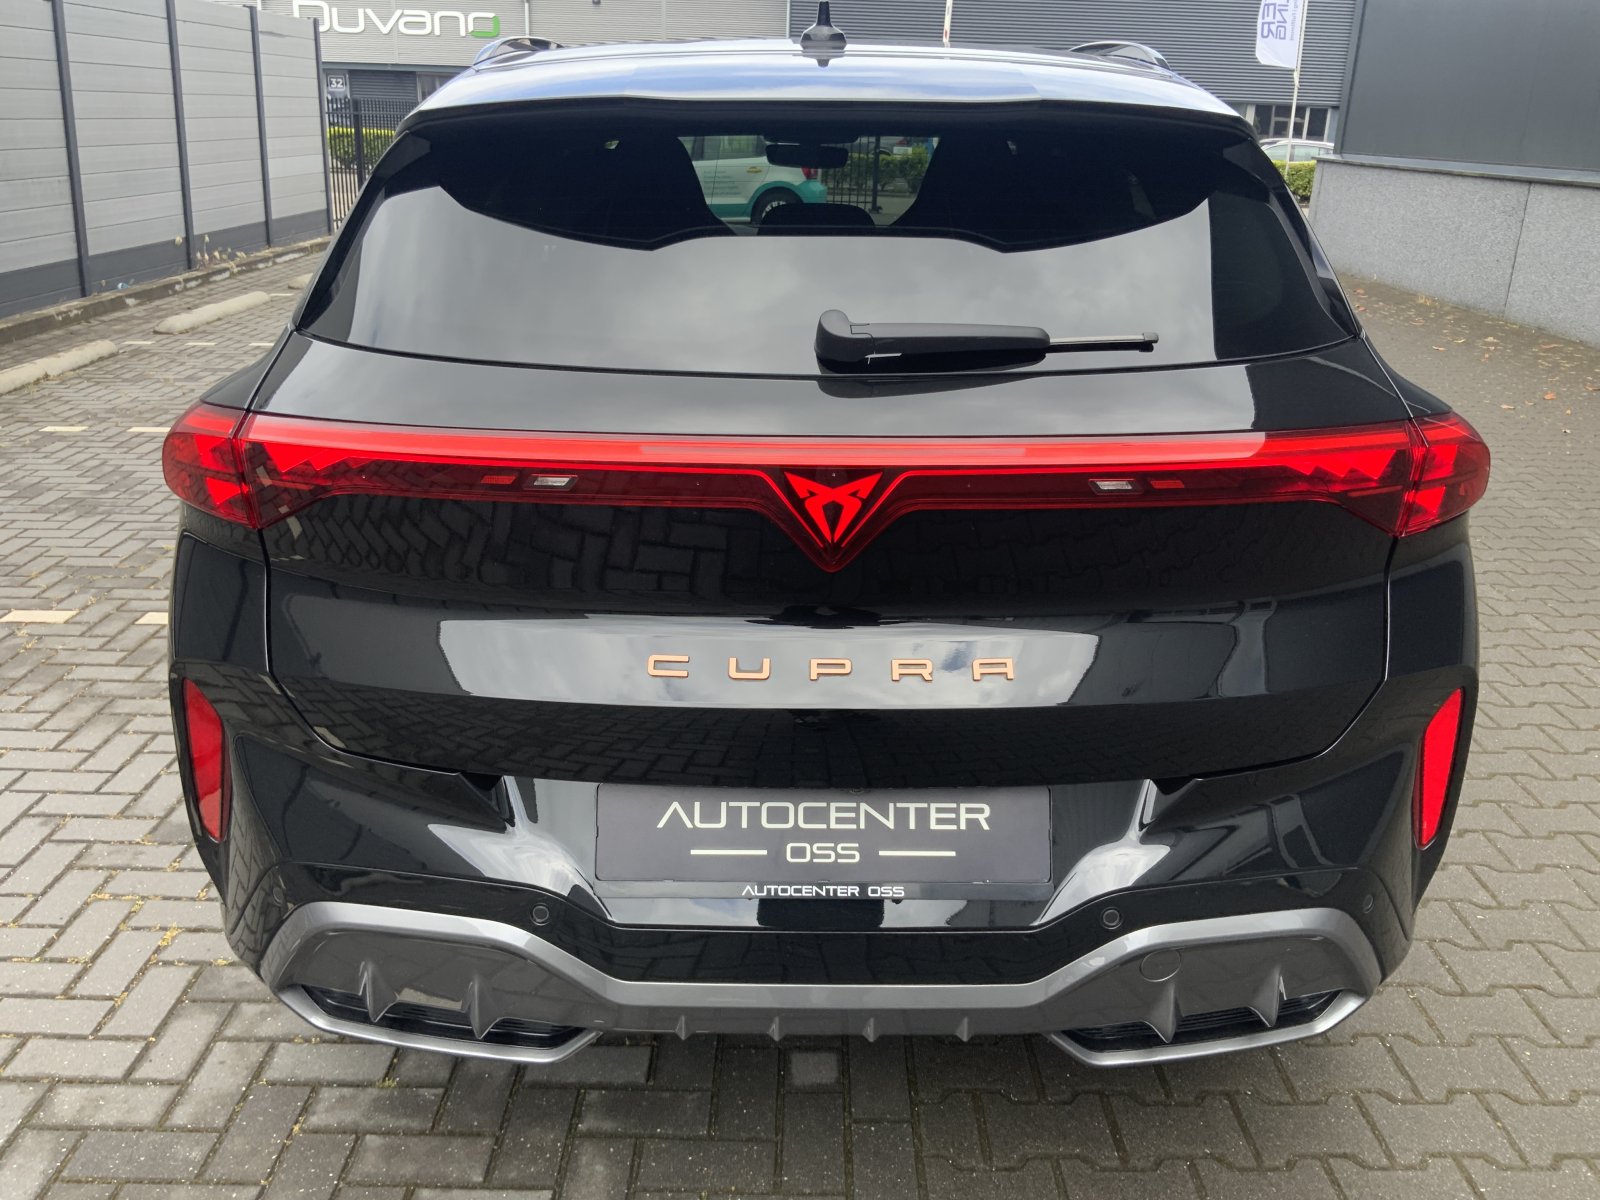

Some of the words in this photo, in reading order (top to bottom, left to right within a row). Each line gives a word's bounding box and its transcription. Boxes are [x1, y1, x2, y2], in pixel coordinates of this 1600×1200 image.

[330, 78, 344, 88] 32
[647, 653, 1015, 682] CUPRA
[656, 801, 992, 831] AUTOCENTER
[785, 842, 861, 864] OSS
[741, 885, 859, 897] AUTOCENTER
[867, 886, 905, 897] OSS
